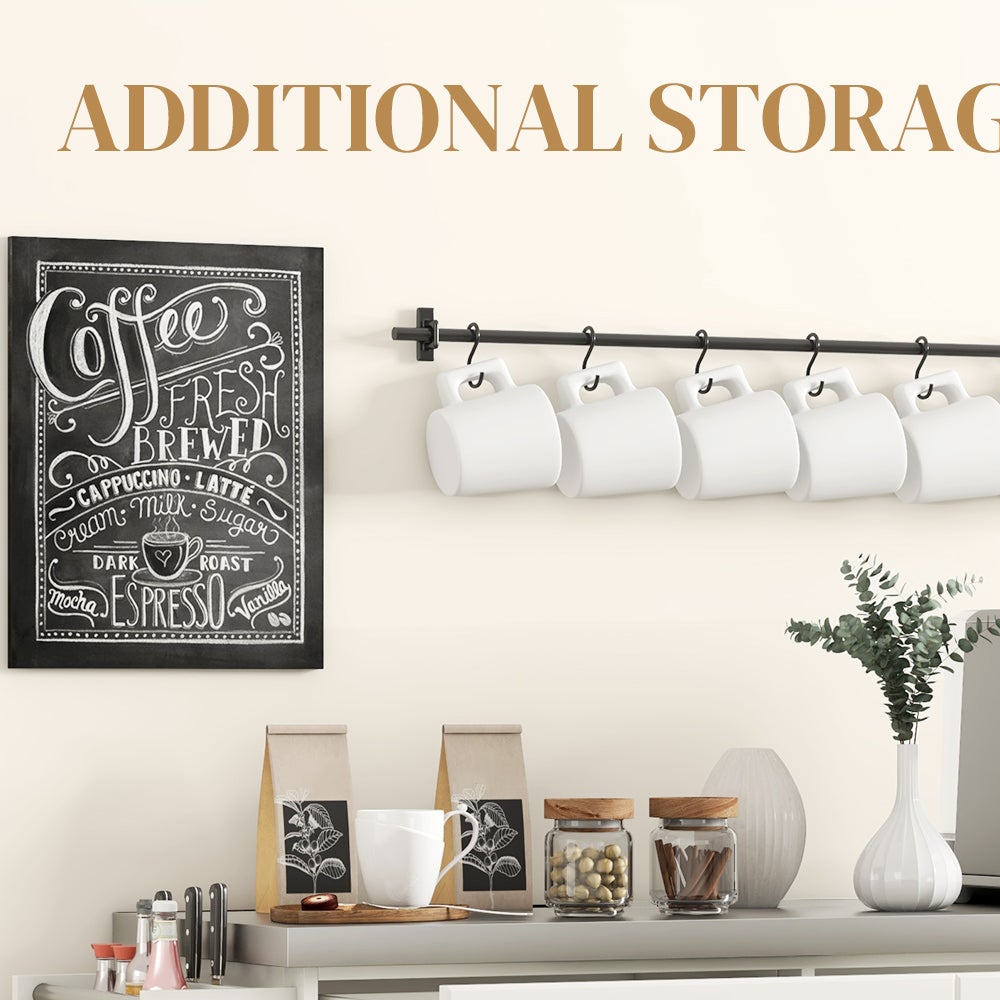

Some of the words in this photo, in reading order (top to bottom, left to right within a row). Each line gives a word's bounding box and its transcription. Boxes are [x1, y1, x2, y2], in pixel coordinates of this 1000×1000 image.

[26, 282, 266, 447] Coffee
[159, 361, 290, 438] FRESH
[131, 418, 271, 465] BREWED
[77, 469, 180, 507] CAPPUCCINO
[200, 499, 279, 545] Sugar
[93, 555, 138, 571] DARK
[200, 555, 253, 572] ROAST
[112, 573, 225, 630] ESPRESSO
[235, 580, 291, 620] Vanilla
